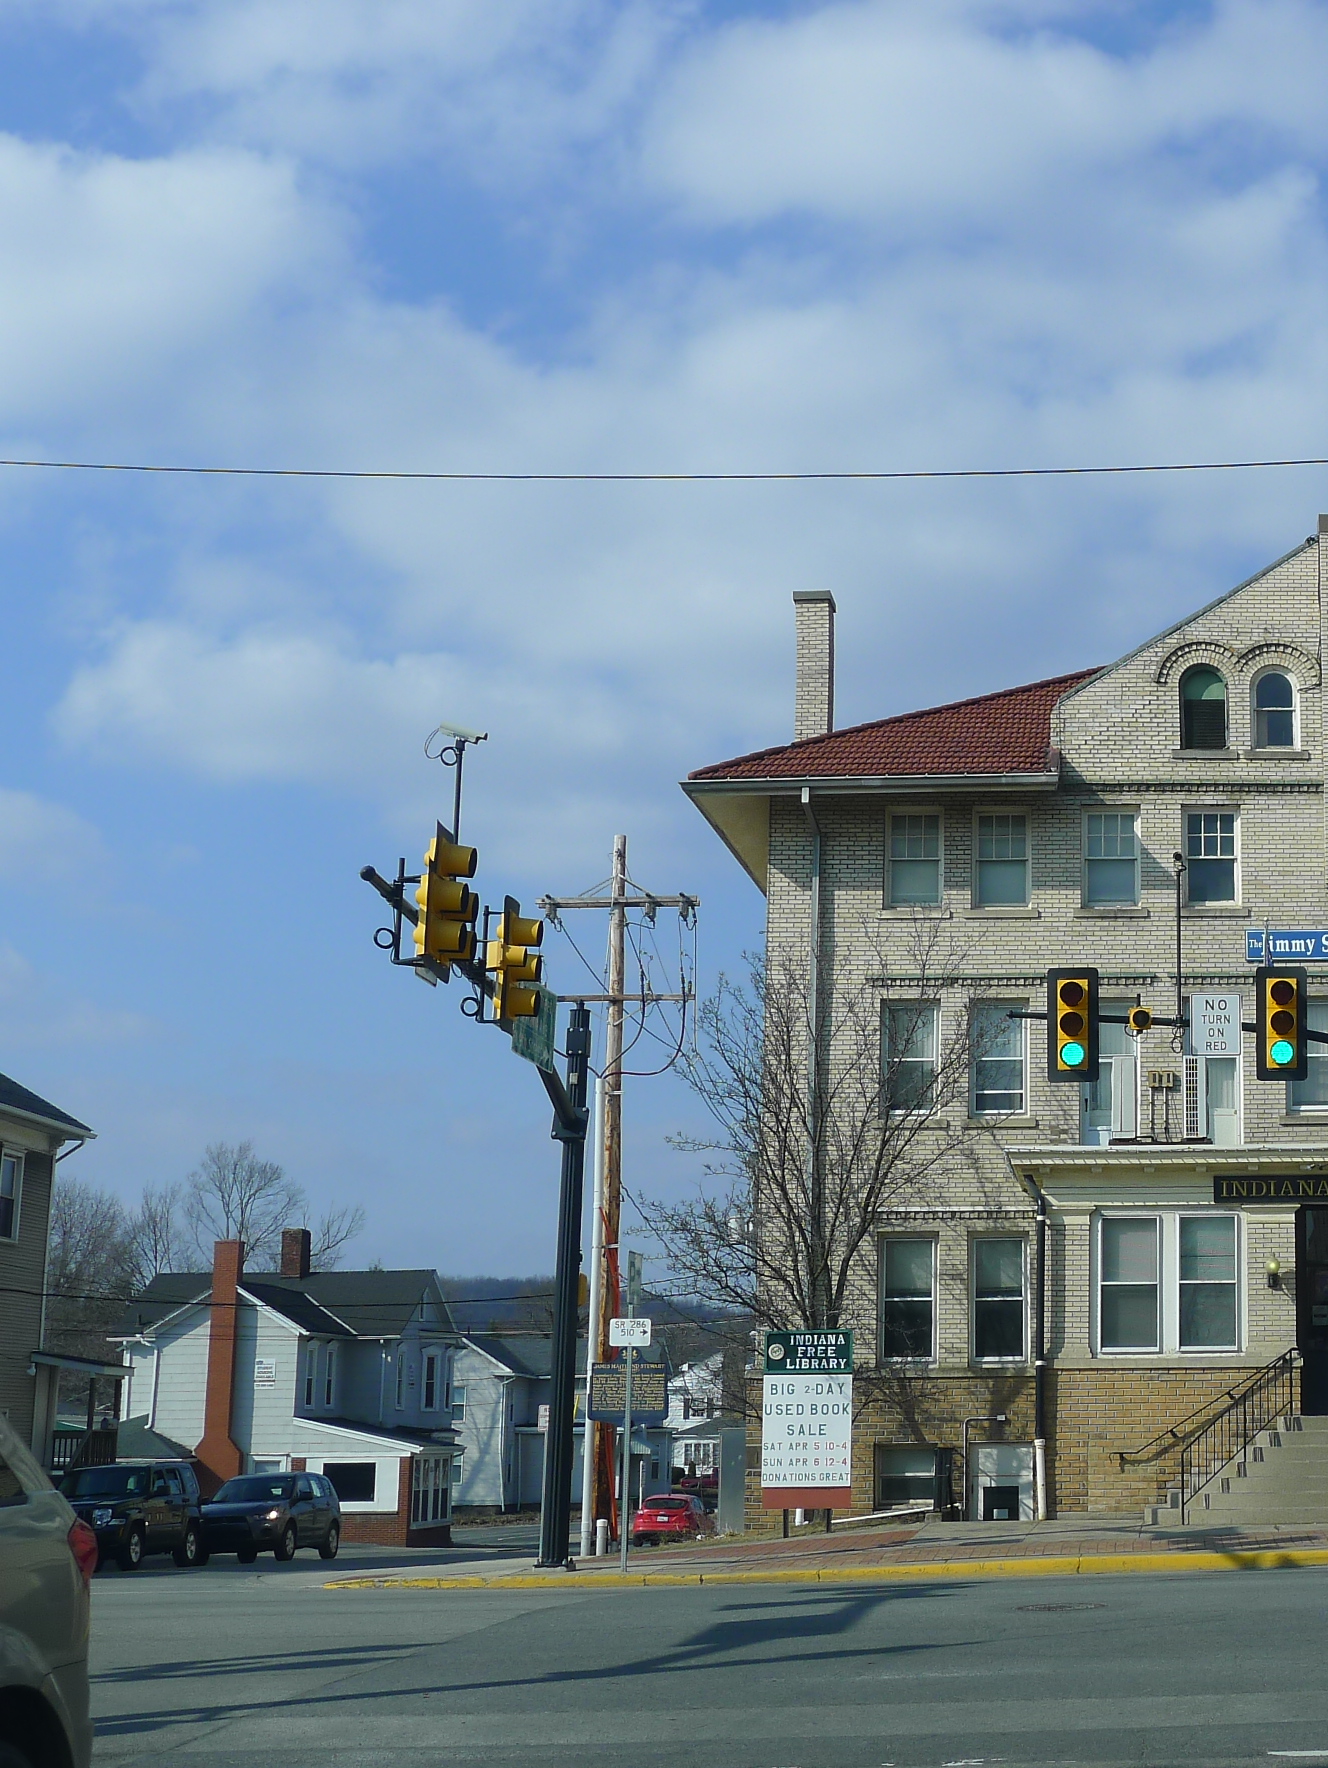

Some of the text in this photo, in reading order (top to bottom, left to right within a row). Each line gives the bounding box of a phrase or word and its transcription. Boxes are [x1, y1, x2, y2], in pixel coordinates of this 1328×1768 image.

[1248, 939, 1262, 948] The
[1205, 999, 1228, 1011] NO
[1201, 1014, 1231, 1025] TURN
[1208, 1027, 1224, 1038] ON
[1205, 1041, 1227, 1051] RED
[614, 1320, 647, 1329] SR 286
[620, 1329, 635, 1337] 510
[789, 1334, 846, 1346] INDIANA
[797, 1346, 837, 1357] FREE
[785, 1358, 848, 1370] LIBRARY
[770, 1382, 845, 1396] BIG 2-DAY
[764, 1402, 850, 1416] USED BOOK
[786, 1423, 827, 1436] SALE
[763, 1441, 848, 1451] SAT APR 5 10-4
[762, 1457, 848, 1467] SUN APR 6 12-4
[762, 1472, 850, 1482] DONATIONS GREAT
